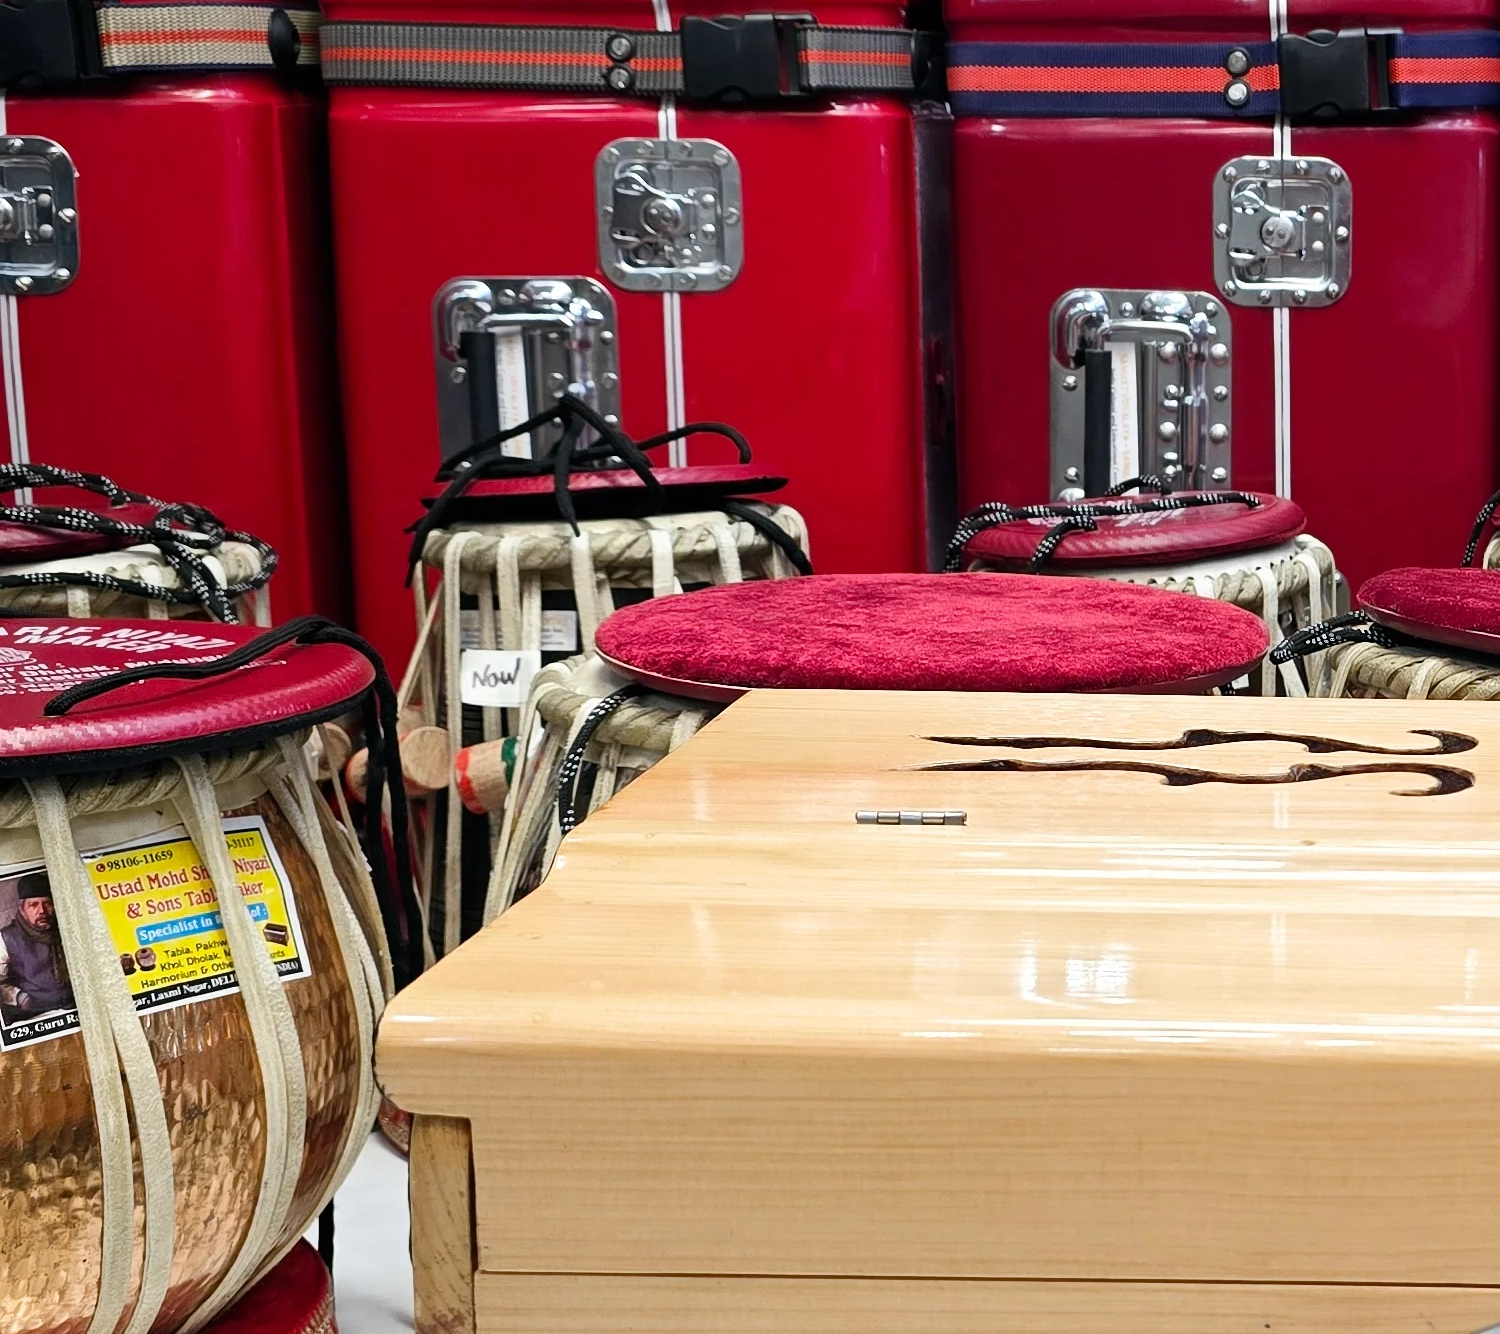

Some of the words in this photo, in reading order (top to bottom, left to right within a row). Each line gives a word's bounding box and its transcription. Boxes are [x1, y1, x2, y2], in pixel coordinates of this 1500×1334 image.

[14, 635, 171, 653] MAKER
[102, 628, 236, 650] NIYAZI
[107, 850, 173, 872] 98106-11659
[97, 877, 144, 900] Ustad
[147, 869, 189, 890] Mohd
[233, 855, 271, 875] Niyazi
[127, 903, 143, 919] &
[146, 897, 182, 915] Sons
[184, 887, 219, 907] Tabl
[140, 919, 199, 941] Specialist
[201, 917, 213, 927] in
[141, 969, 198, 988] Harmonium
[35, 1019, 64, 1032] Guru
[151, 986, 182, 1002] Laxmi
